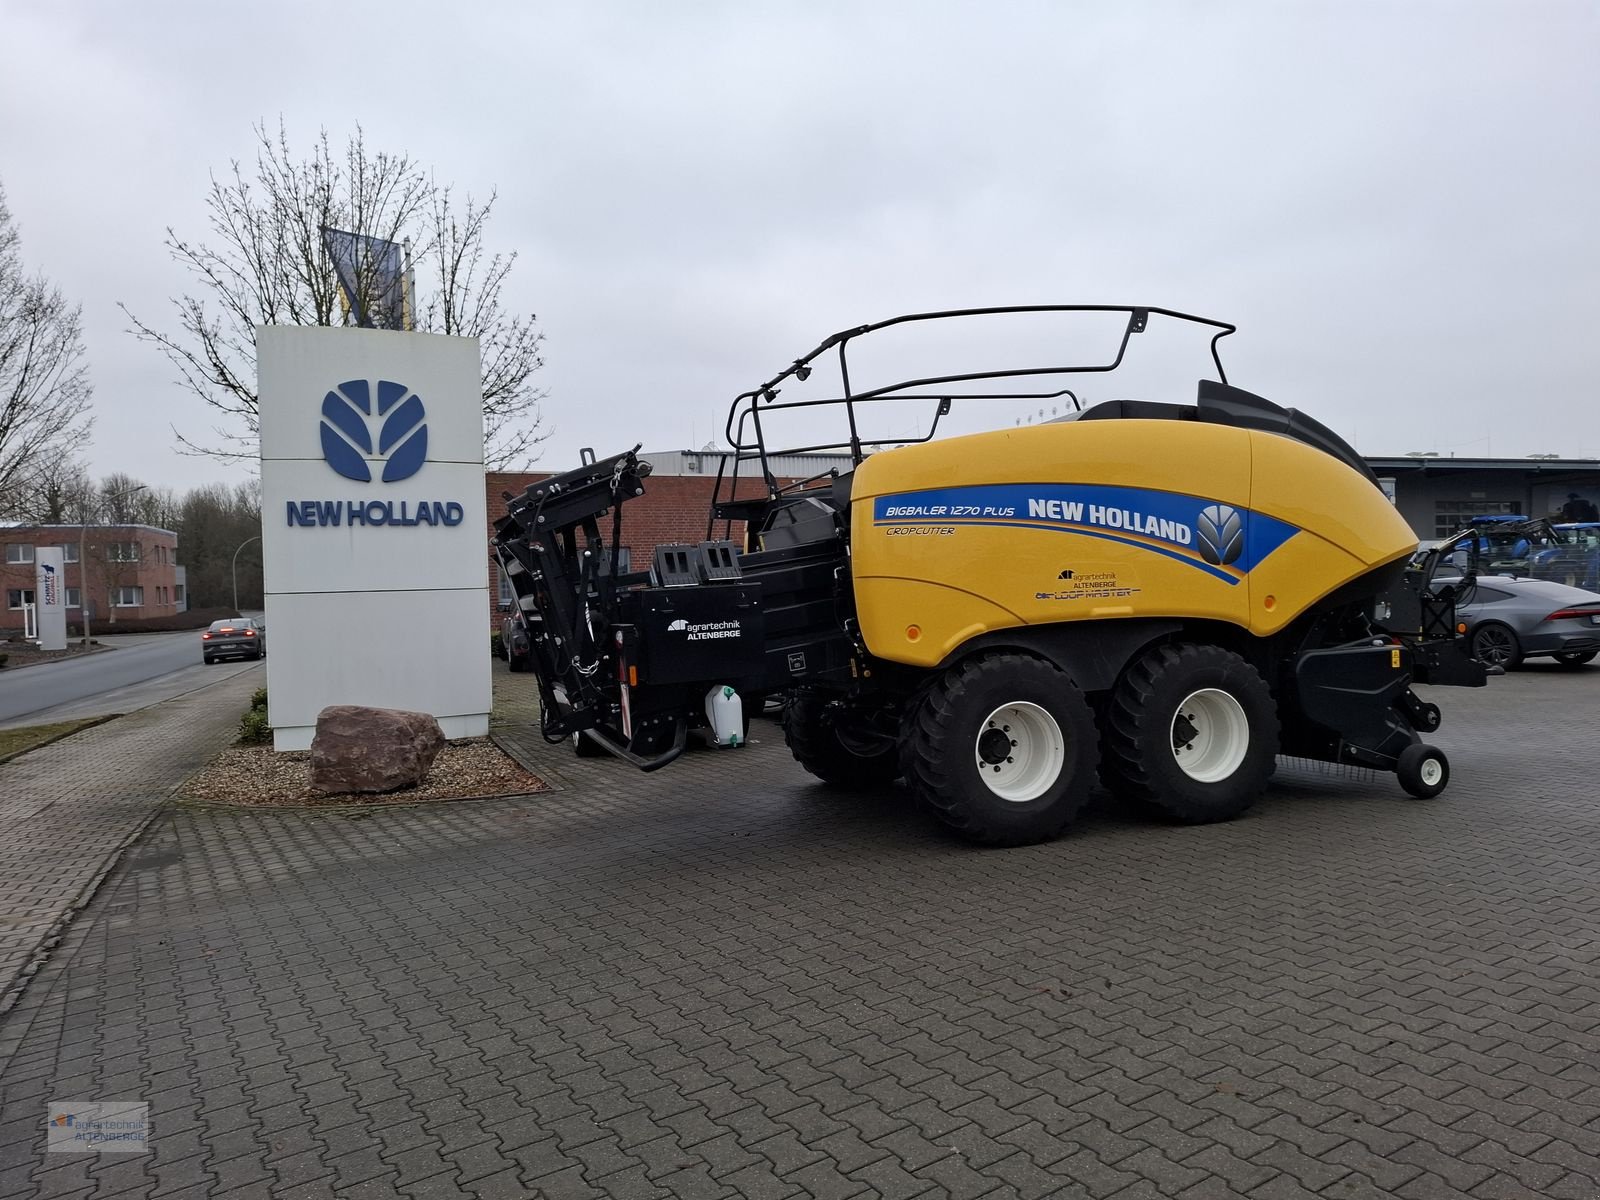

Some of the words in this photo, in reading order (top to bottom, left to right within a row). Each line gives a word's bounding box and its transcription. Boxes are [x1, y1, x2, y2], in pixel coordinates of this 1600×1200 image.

[286, 500, 342, 527] NEW
[348, 500, 464, 527] HOLLAND
[886, 506, 947, 517] BIGBALER
[950, 506, 980, 516] 1270
[983, 507, 1016, 517] PLUS
[1028, 498, 1084, 522] NEW
[1089, 504, 1192, 545] HOLLAND
[886, 527, 956, 536] CROPCUTTER
[1073, 572, 1117, 582] agrartechnik
[1073, 581, 1117, 589] ALTENBERGE
[687, 619, 740, 632] agrartechnik
[687, 629, 741, 641] ALTENBERGE
